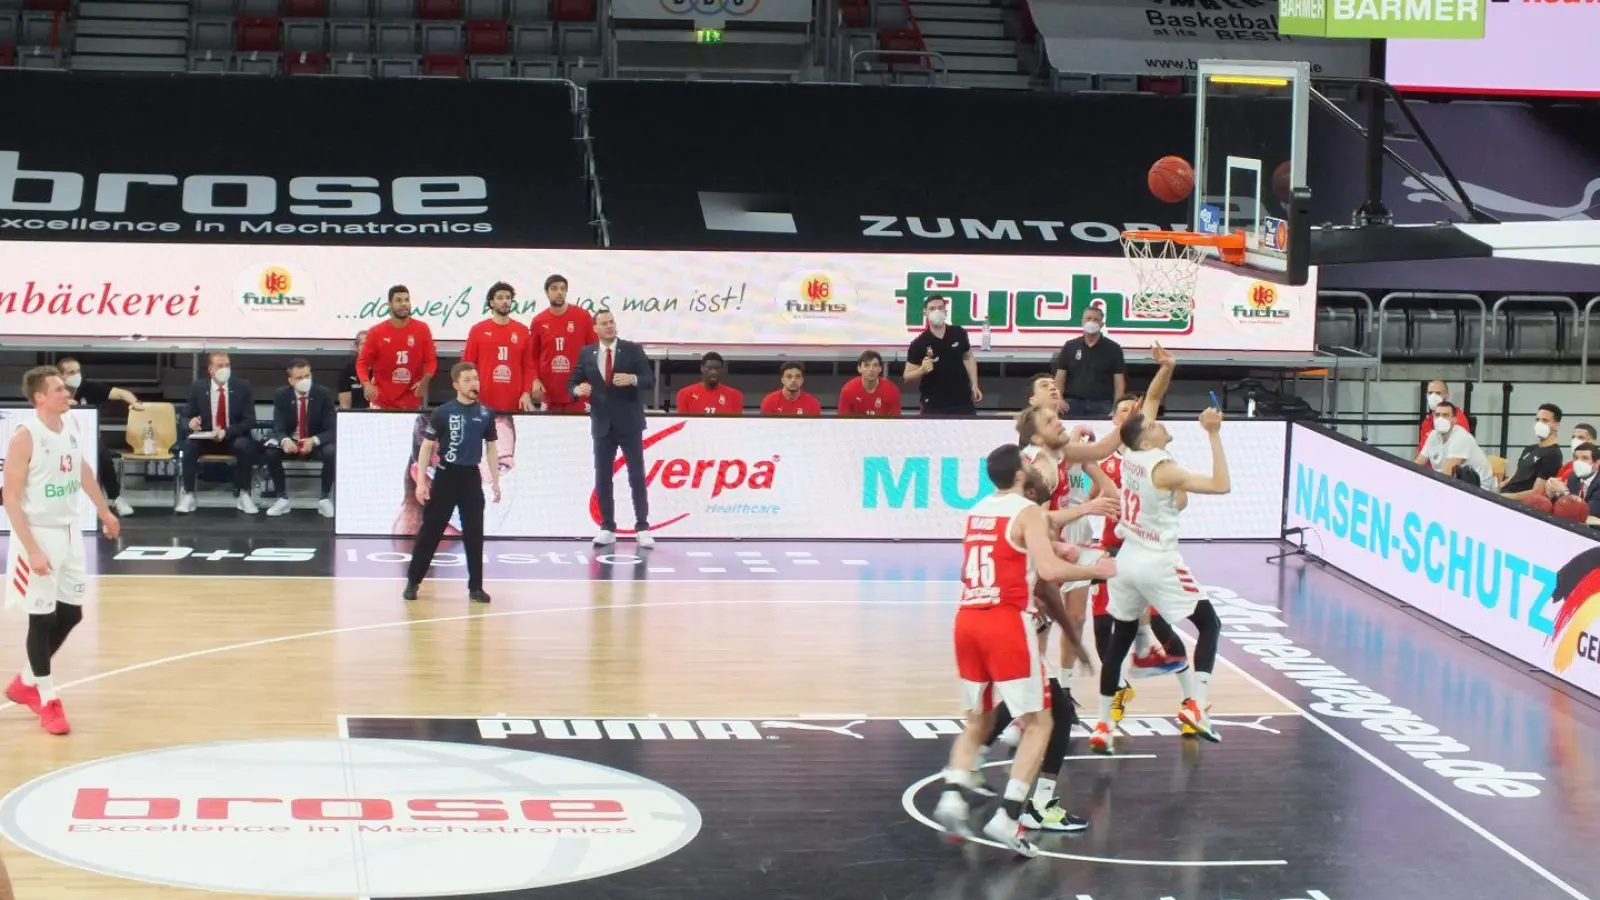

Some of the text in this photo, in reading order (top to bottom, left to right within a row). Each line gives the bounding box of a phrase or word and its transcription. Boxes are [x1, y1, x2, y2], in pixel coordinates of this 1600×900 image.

[1145, 10, 1279, 30] Basketbal
[1334, 0, 1477, 21] BARMER
[0, 150, 488, 215] brose
[0, 217, 493, 235] xcellence in Mechatronics
[860, 214, 1189, 243] ZUMTOB
[242, 292, 306, 305] fuchs
[482, 299, 537, 318] an
[622, 296, 678, 313] man
[689, 283, 747, 313] isst!
[785, 299, 847, 312] fuchs
[895, 271, 1195, 335] fuchs
[1232, 305, 1291, 318] fuchs
[60, 455, 73, 473] 43
[862, 456, 986, 510] MU
[347, 549, 643, 568] logstic
[1297, 462, 1558, 636] NASEN-SCHUTZ
[965, 545, 996, 588] 45
[1577, 631, 1600, 664] GE
[477, 719, 762, 740] PUMA
[899, 719, 1182, 740] PA
[72, 788, 628, 821] brose
[68, 824, 636, 834] Excellence in Mechatronics
